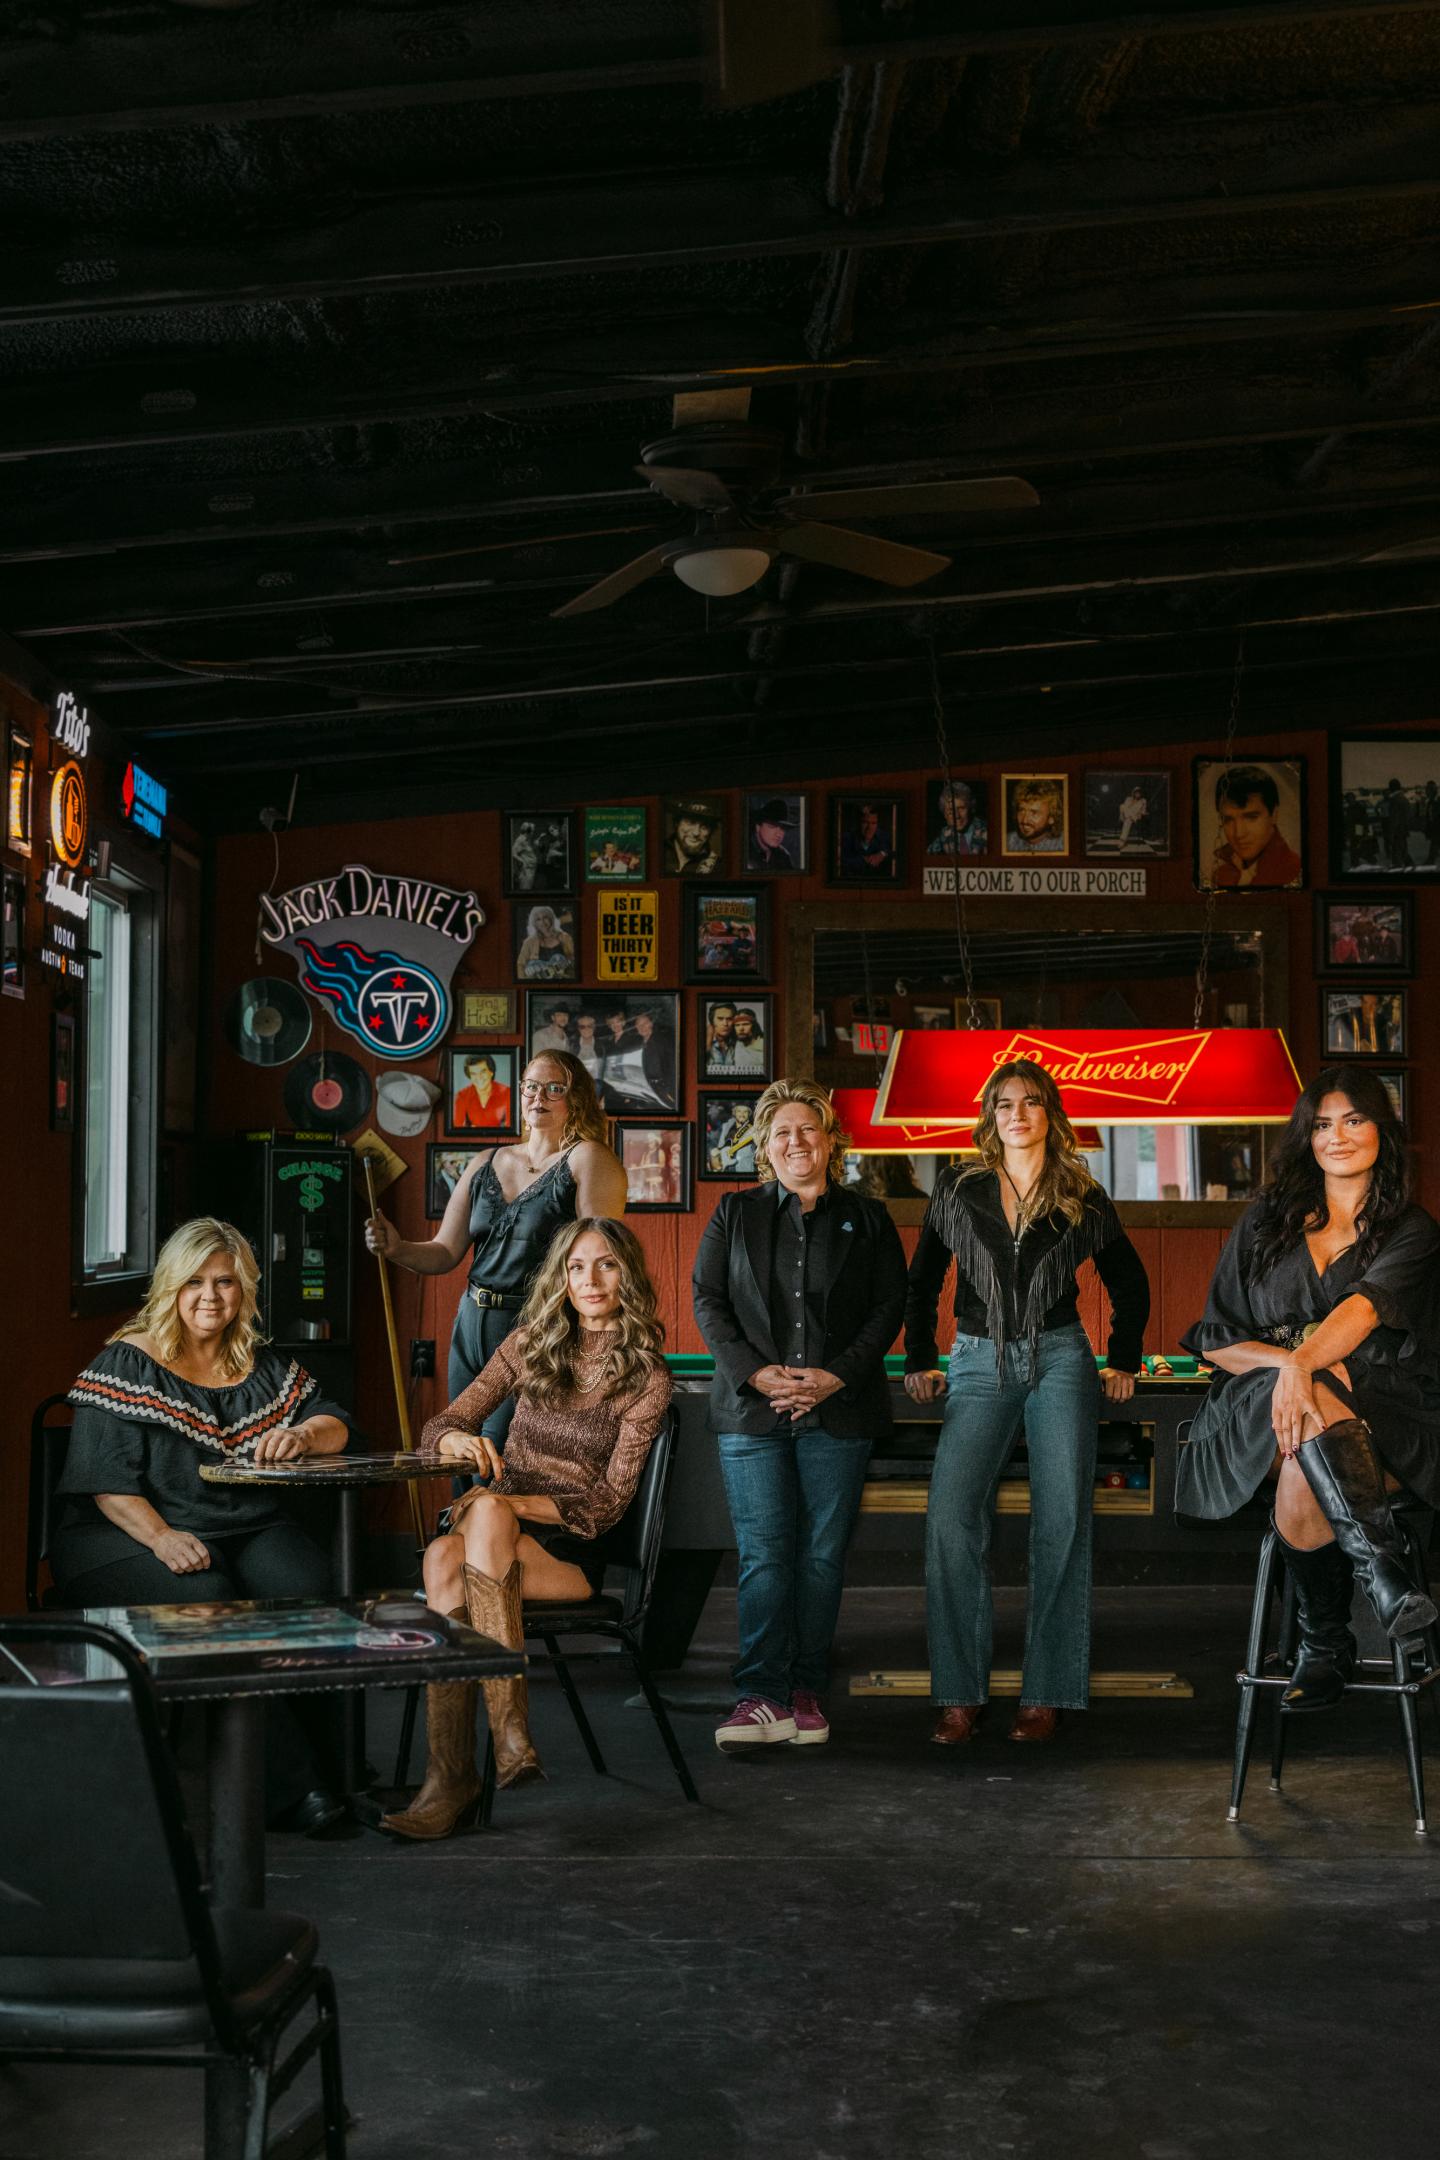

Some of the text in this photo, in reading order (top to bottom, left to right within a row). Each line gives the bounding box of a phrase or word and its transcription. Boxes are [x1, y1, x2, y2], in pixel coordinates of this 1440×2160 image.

[56, 692, 90, 757] Tito's
[928, 870, 1142, 892] WELCOME TO OUR PORCH
[261, 867, 483, 944] JACK DANIEL'S
[614, 898, 642, 911] IS IT
[603, 914, 654, 935] BEER
[54, 925, 75, 951] VODKA
[603, 939, 652, 953] THIRTY
[42, 948, 84, 979] AUSTIN TEXAS
[609, 956, 649, 973] YET?
[278, 1161, 343, 1182] CHANGE
